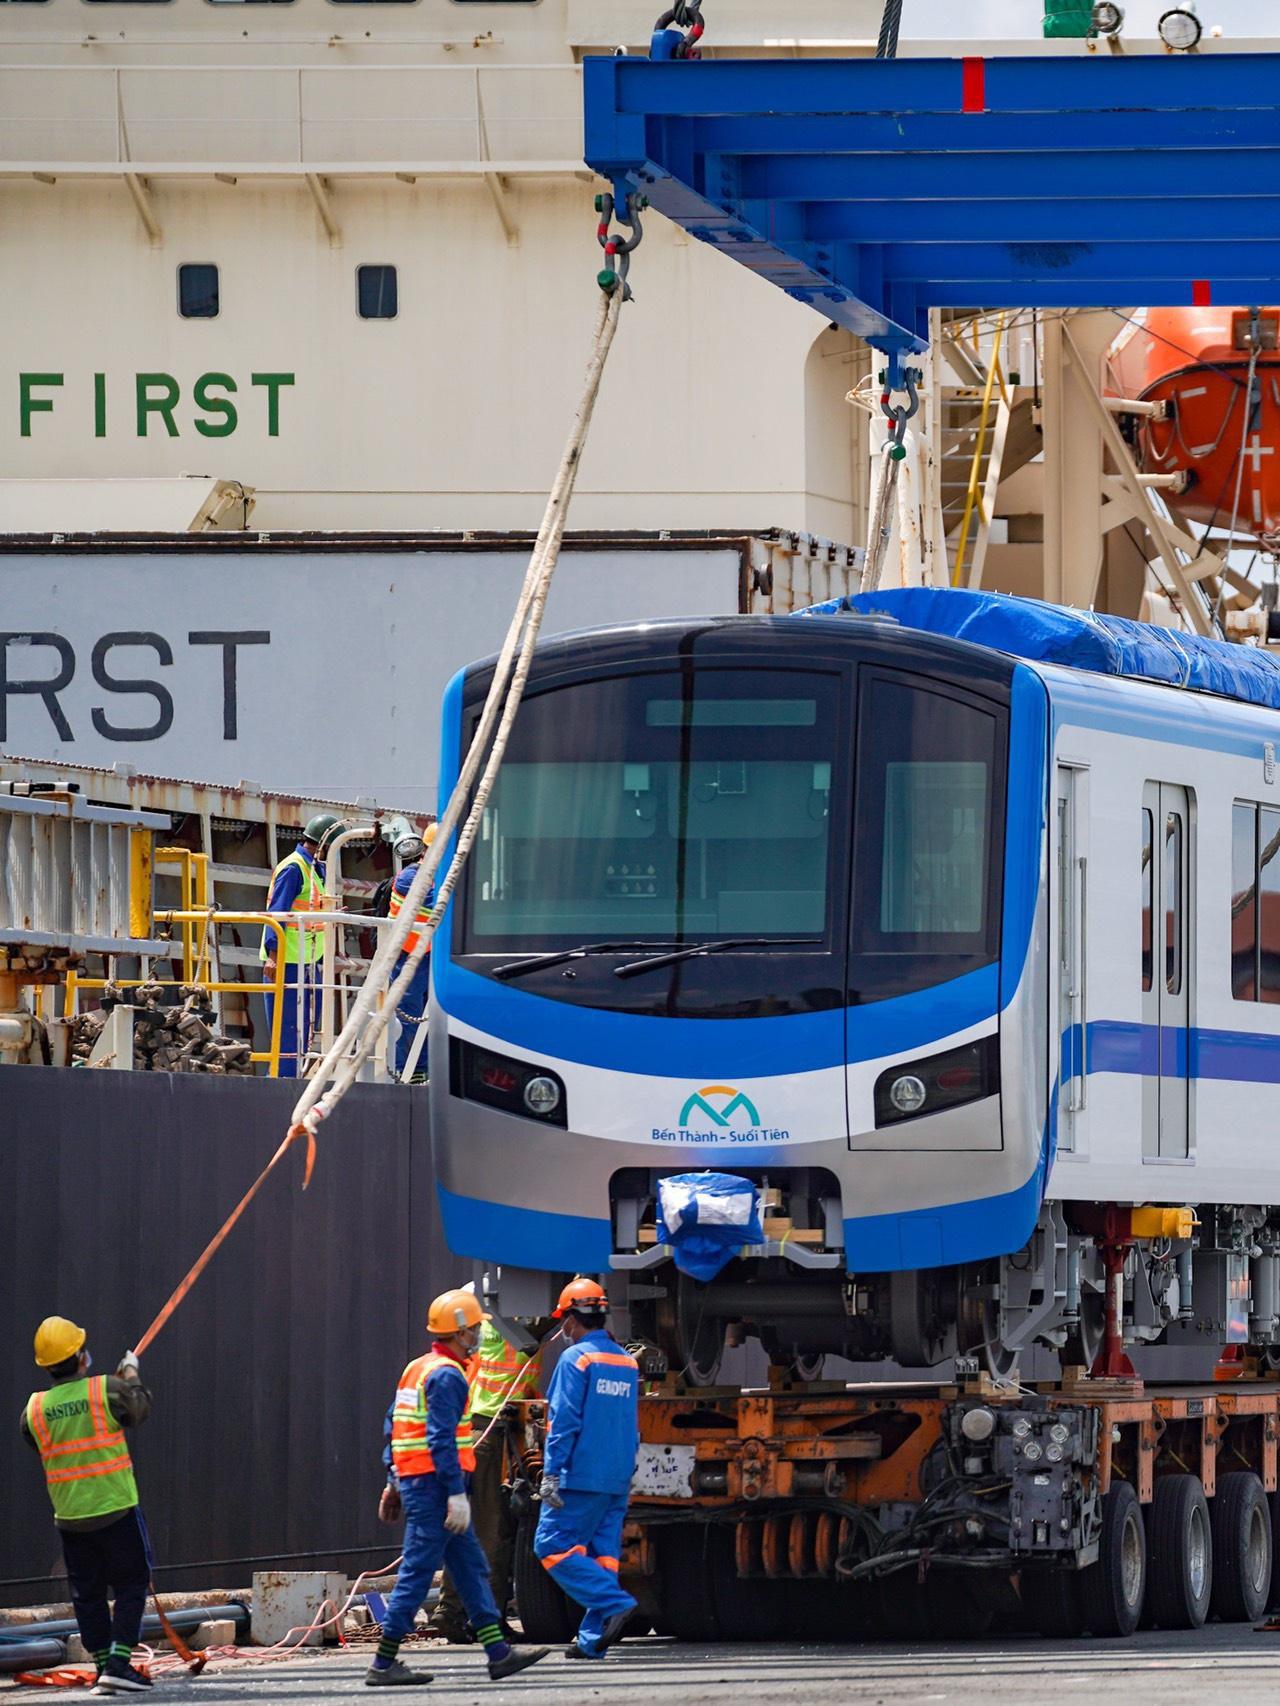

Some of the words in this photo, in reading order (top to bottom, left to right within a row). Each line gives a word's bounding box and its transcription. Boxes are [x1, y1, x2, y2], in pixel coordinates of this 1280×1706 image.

[20, 371, 296, 438] FIRST
[0, 630, 271, 742] RST
[652, 1128, 676, 1141] Bến
[678, 1130, 718, 1143] Thành
[730, 1128, 759, 1142] Suối
[759, 1128, 790, 1141] Tiên
[45, 1399, 89, 1421] SASTECO
